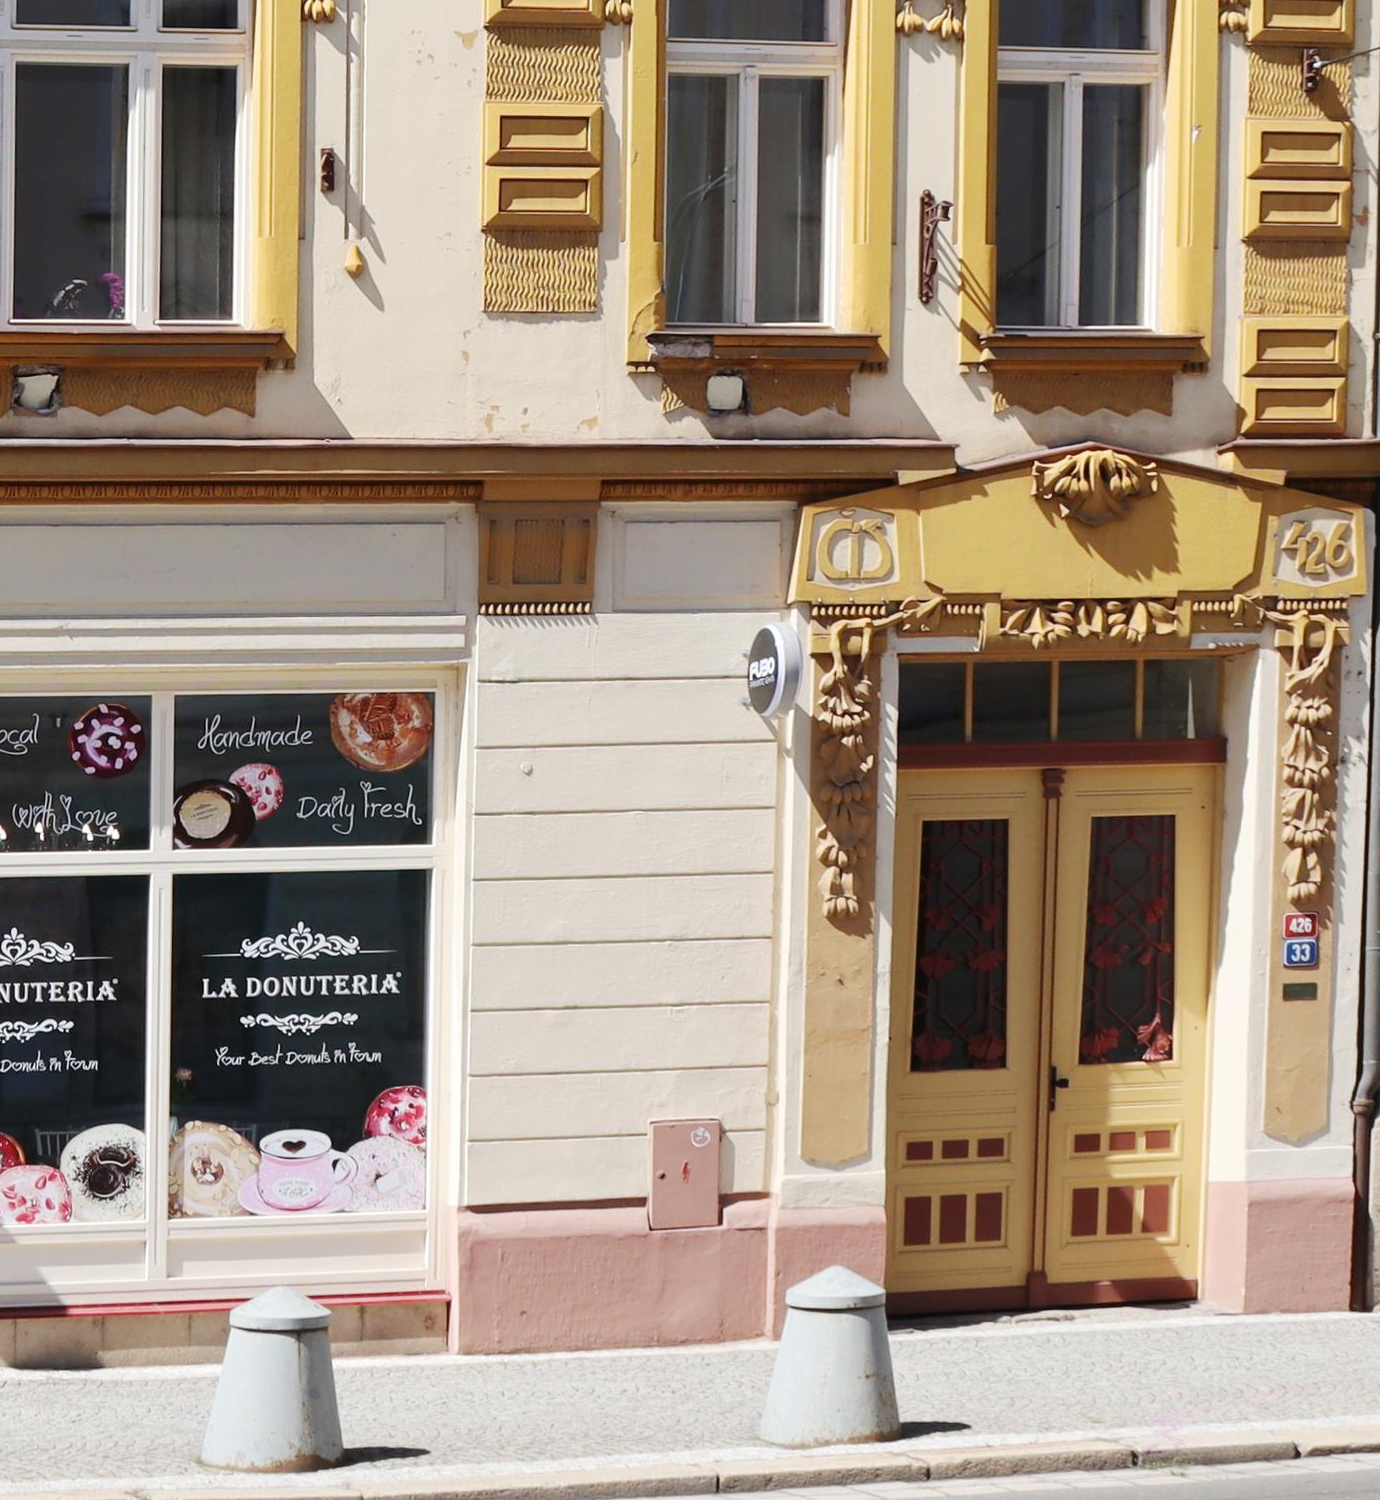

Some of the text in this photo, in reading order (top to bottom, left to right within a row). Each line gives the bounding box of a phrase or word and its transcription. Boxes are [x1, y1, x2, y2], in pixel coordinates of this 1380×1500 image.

[1280, 520, 1350, 574] 426
[749, 656, 776, 681] FUBO
[197, 714, 314, 755] Handmade
[61, 794, 120, 838] Love
[296, 780, 423, 835] Daily Fresh
[1289, 917, 1313, 933] 426
[1291, 944, 1311, 962] 33
[202, 972, 402, 998] LA DONUTERIA
[0, 1050, 47, 1073] Donuts
[49, 1057, 62, 1072] in
[214, 1046, 246, 1067] Your
[248, 1043, 282, 1067] Best
[285, 1042, 332, 1065] Donuts
[334, 1049, 347, 1064] in
